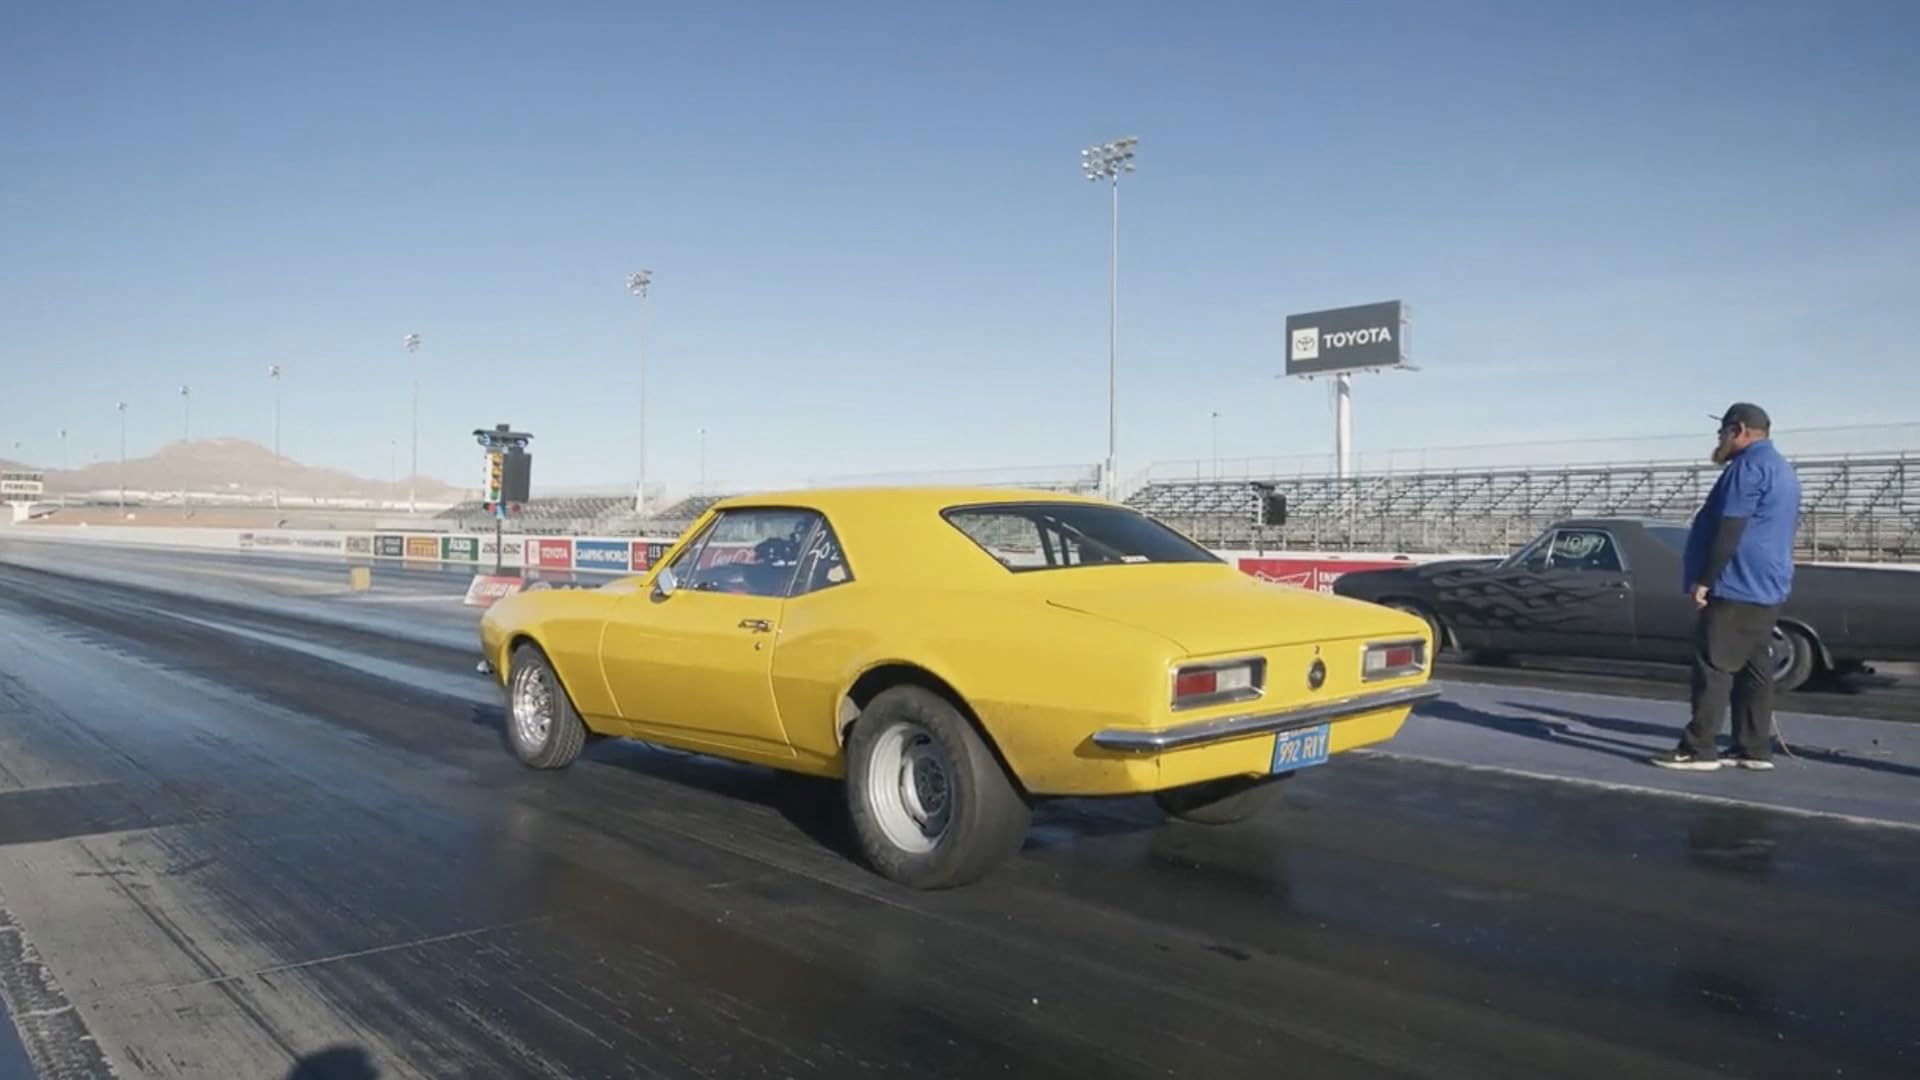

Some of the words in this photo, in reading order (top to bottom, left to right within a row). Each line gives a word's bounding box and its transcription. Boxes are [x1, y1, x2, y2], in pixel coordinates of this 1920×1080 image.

[1323, 327, 1392, 349] TOYOTA
[541, 546, 569, 559] TOYOTA
[1278, 739, 1301, 764] 992
